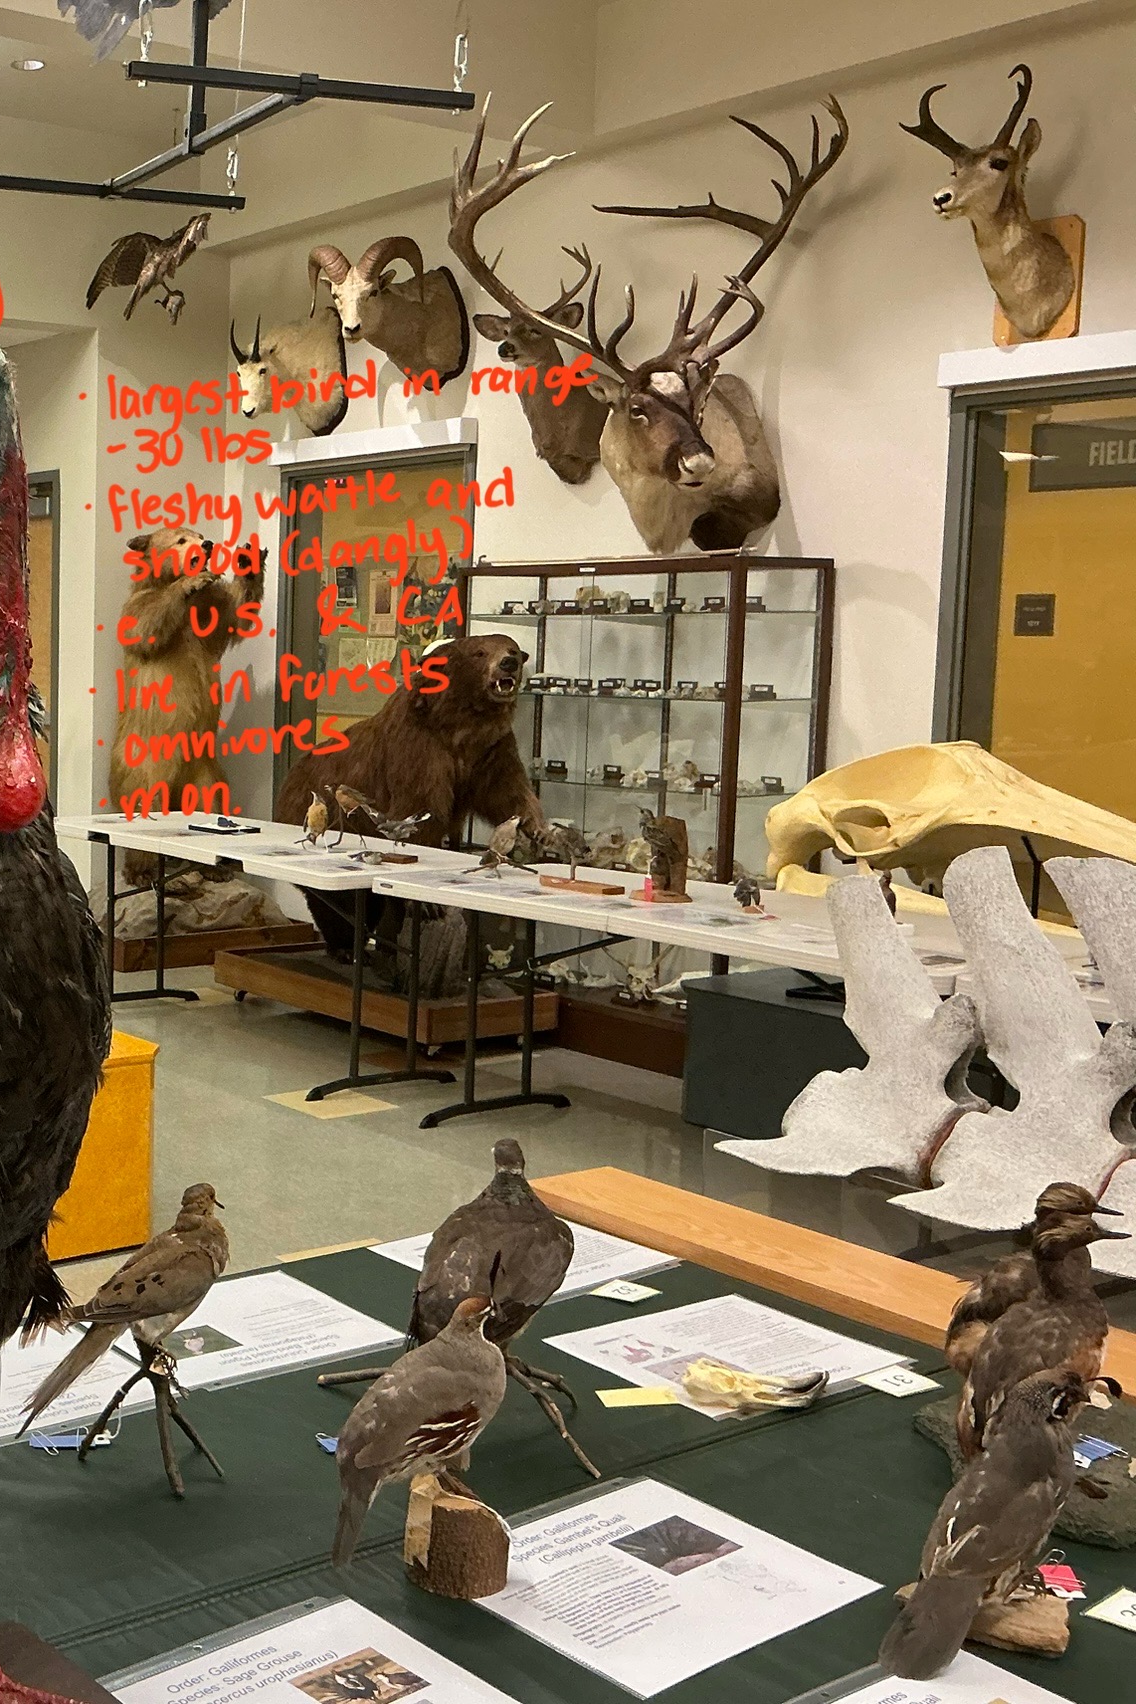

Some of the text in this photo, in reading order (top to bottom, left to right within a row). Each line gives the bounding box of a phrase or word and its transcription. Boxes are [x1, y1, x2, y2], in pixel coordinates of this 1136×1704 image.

[611, 1285, 637, 1296] 32
[882, 1374, 914, 1387] 31
[167, 1645, 277, 1694] Order: Galliformes
[223, 1668, 258, 1687] Sage
[257, 1650, 303, 1672] Grouse
[255, 1649, 339, 1689] urophasianus)
